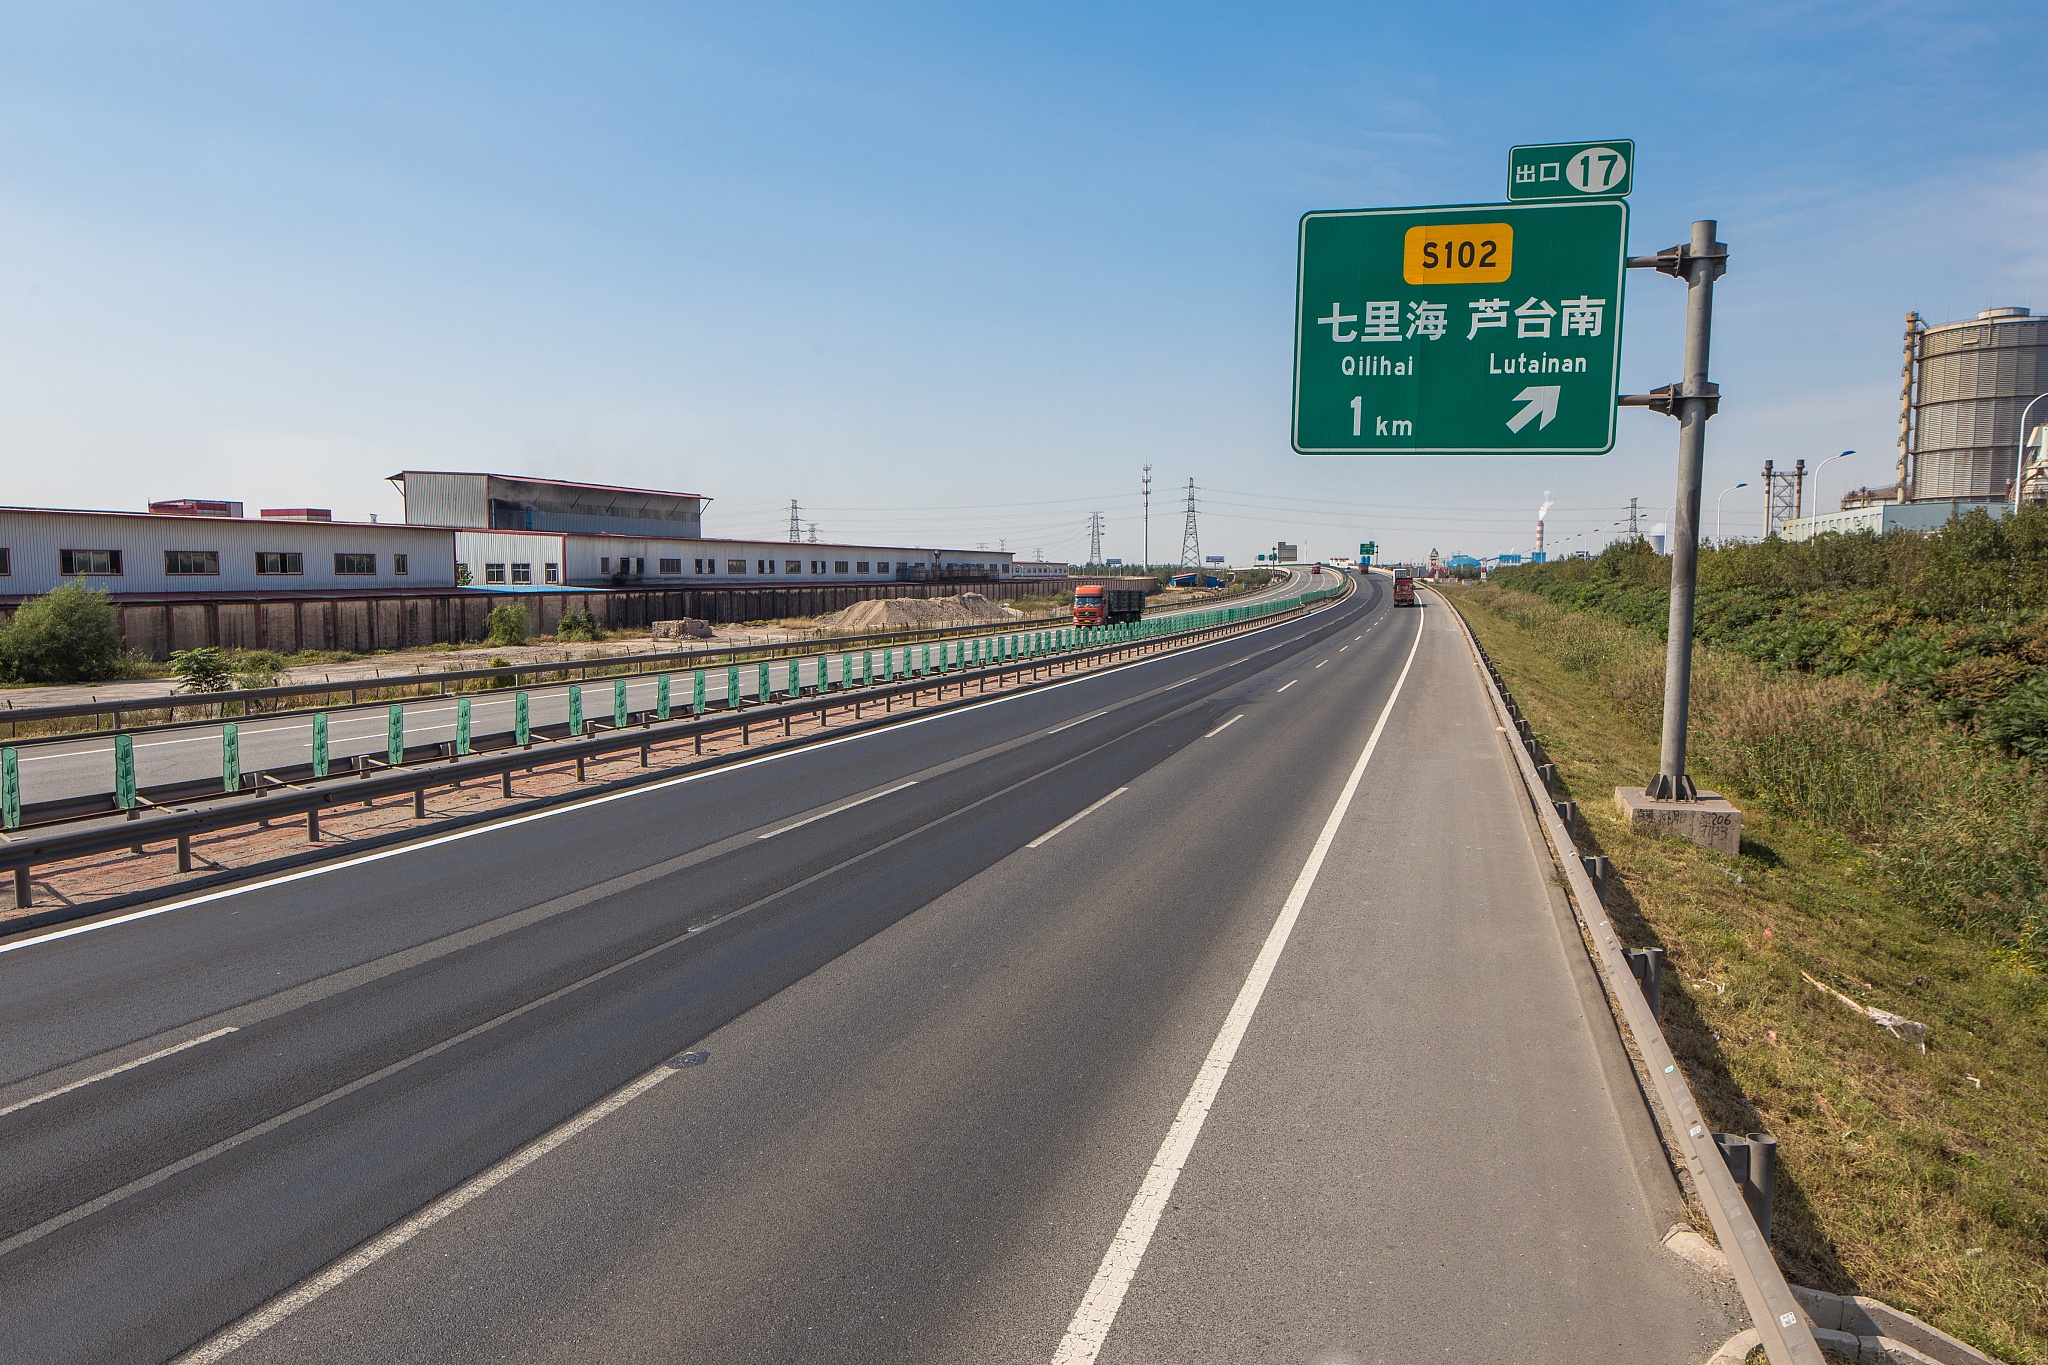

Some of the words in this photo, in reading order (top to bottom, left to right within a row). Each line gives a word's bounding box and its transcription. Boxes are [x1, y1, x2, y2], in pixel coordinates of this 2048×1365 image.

[1515, 162, 1560, 184] 出口
[1580, 154, 1618, 187] 17
[1422, 240, 1497, 269] S102
[1317, 300, 1448, 343] 七里海
[1466, 295, 1606, 341] 芦台南
[1341, 355, 1413, 376] Qilihai
[1489, 352, 1587, 375] Lutainan
[1350, 395, 1362, 436] 1
[1375, 416, 1412, 436] km
